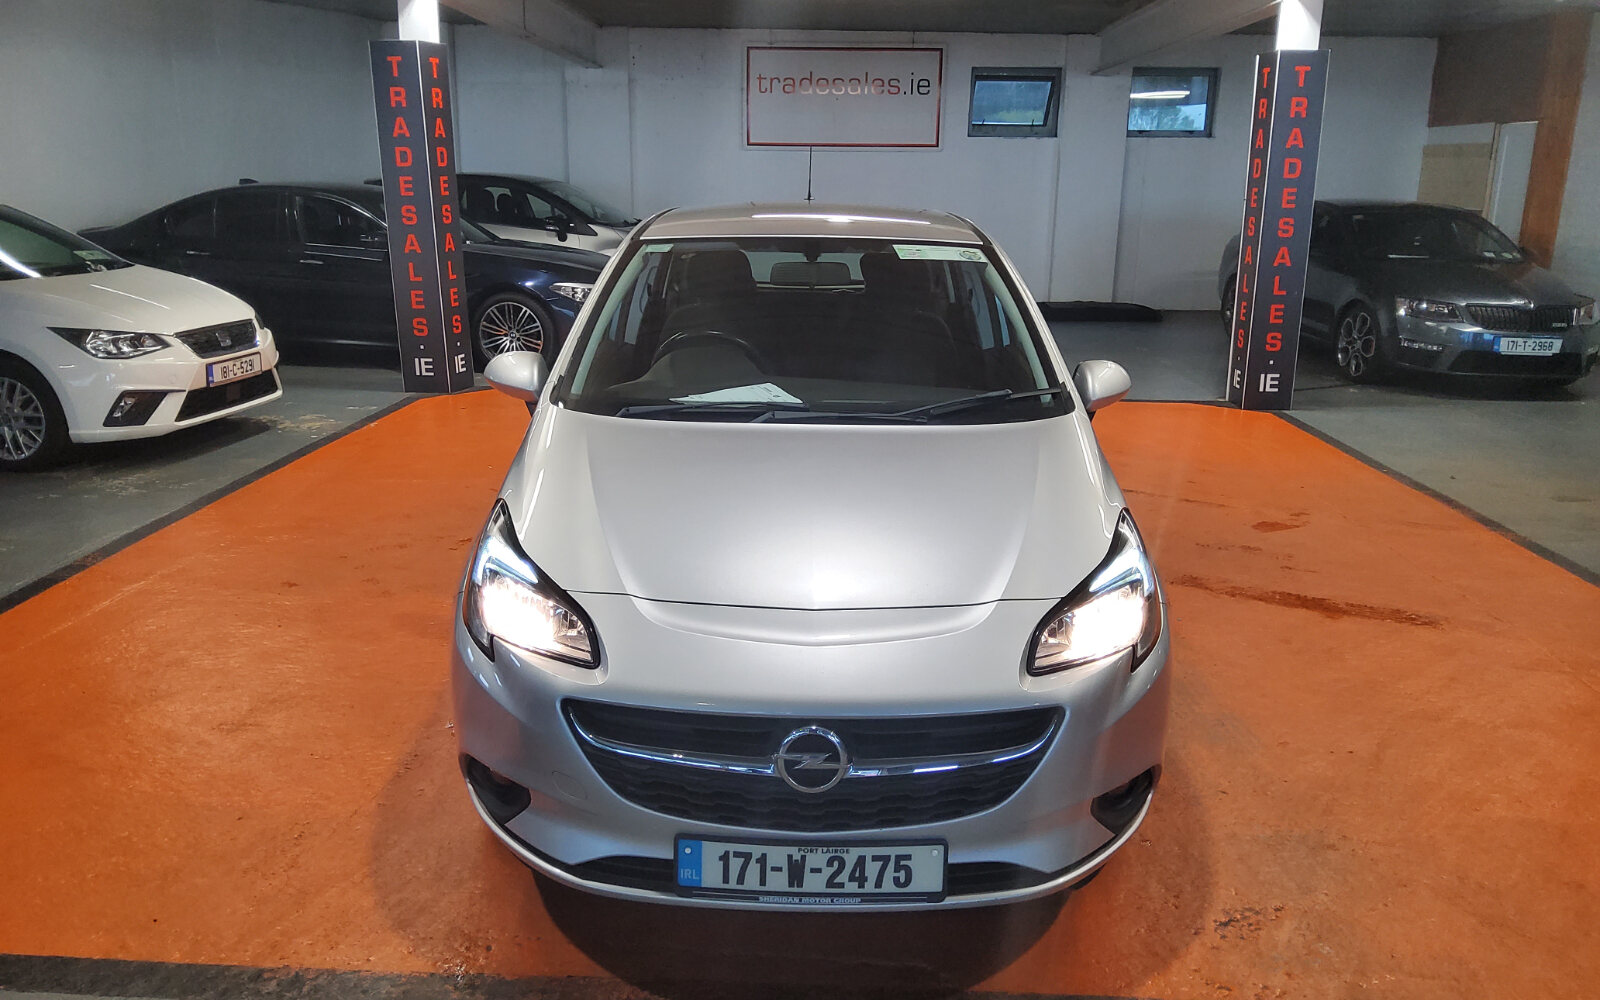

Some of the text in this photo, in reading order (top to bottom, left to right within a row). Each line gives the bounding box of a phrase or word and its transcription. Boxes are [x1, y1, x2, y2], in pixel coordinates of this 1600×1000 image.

[756, 71, 931, 96] tradesales.ie
[387, 56, 435, 376] TRADESALES.IE
[429, 57, 467, 374] TRADESALES.IE
[1233, 67, 1271, 389] TRADESALES.IE
[1259, 65, 1311, 392] TRADESALES.IE
[1506, 340, 1554, 352] 171-T-2968
[220, 359, 255, 380] 181-C-5291
[680, 868, 700, 880] IRL
[718, 850, 913, 889] 171-W-2475
[759, 896, 800, 904] SHERIDAN
